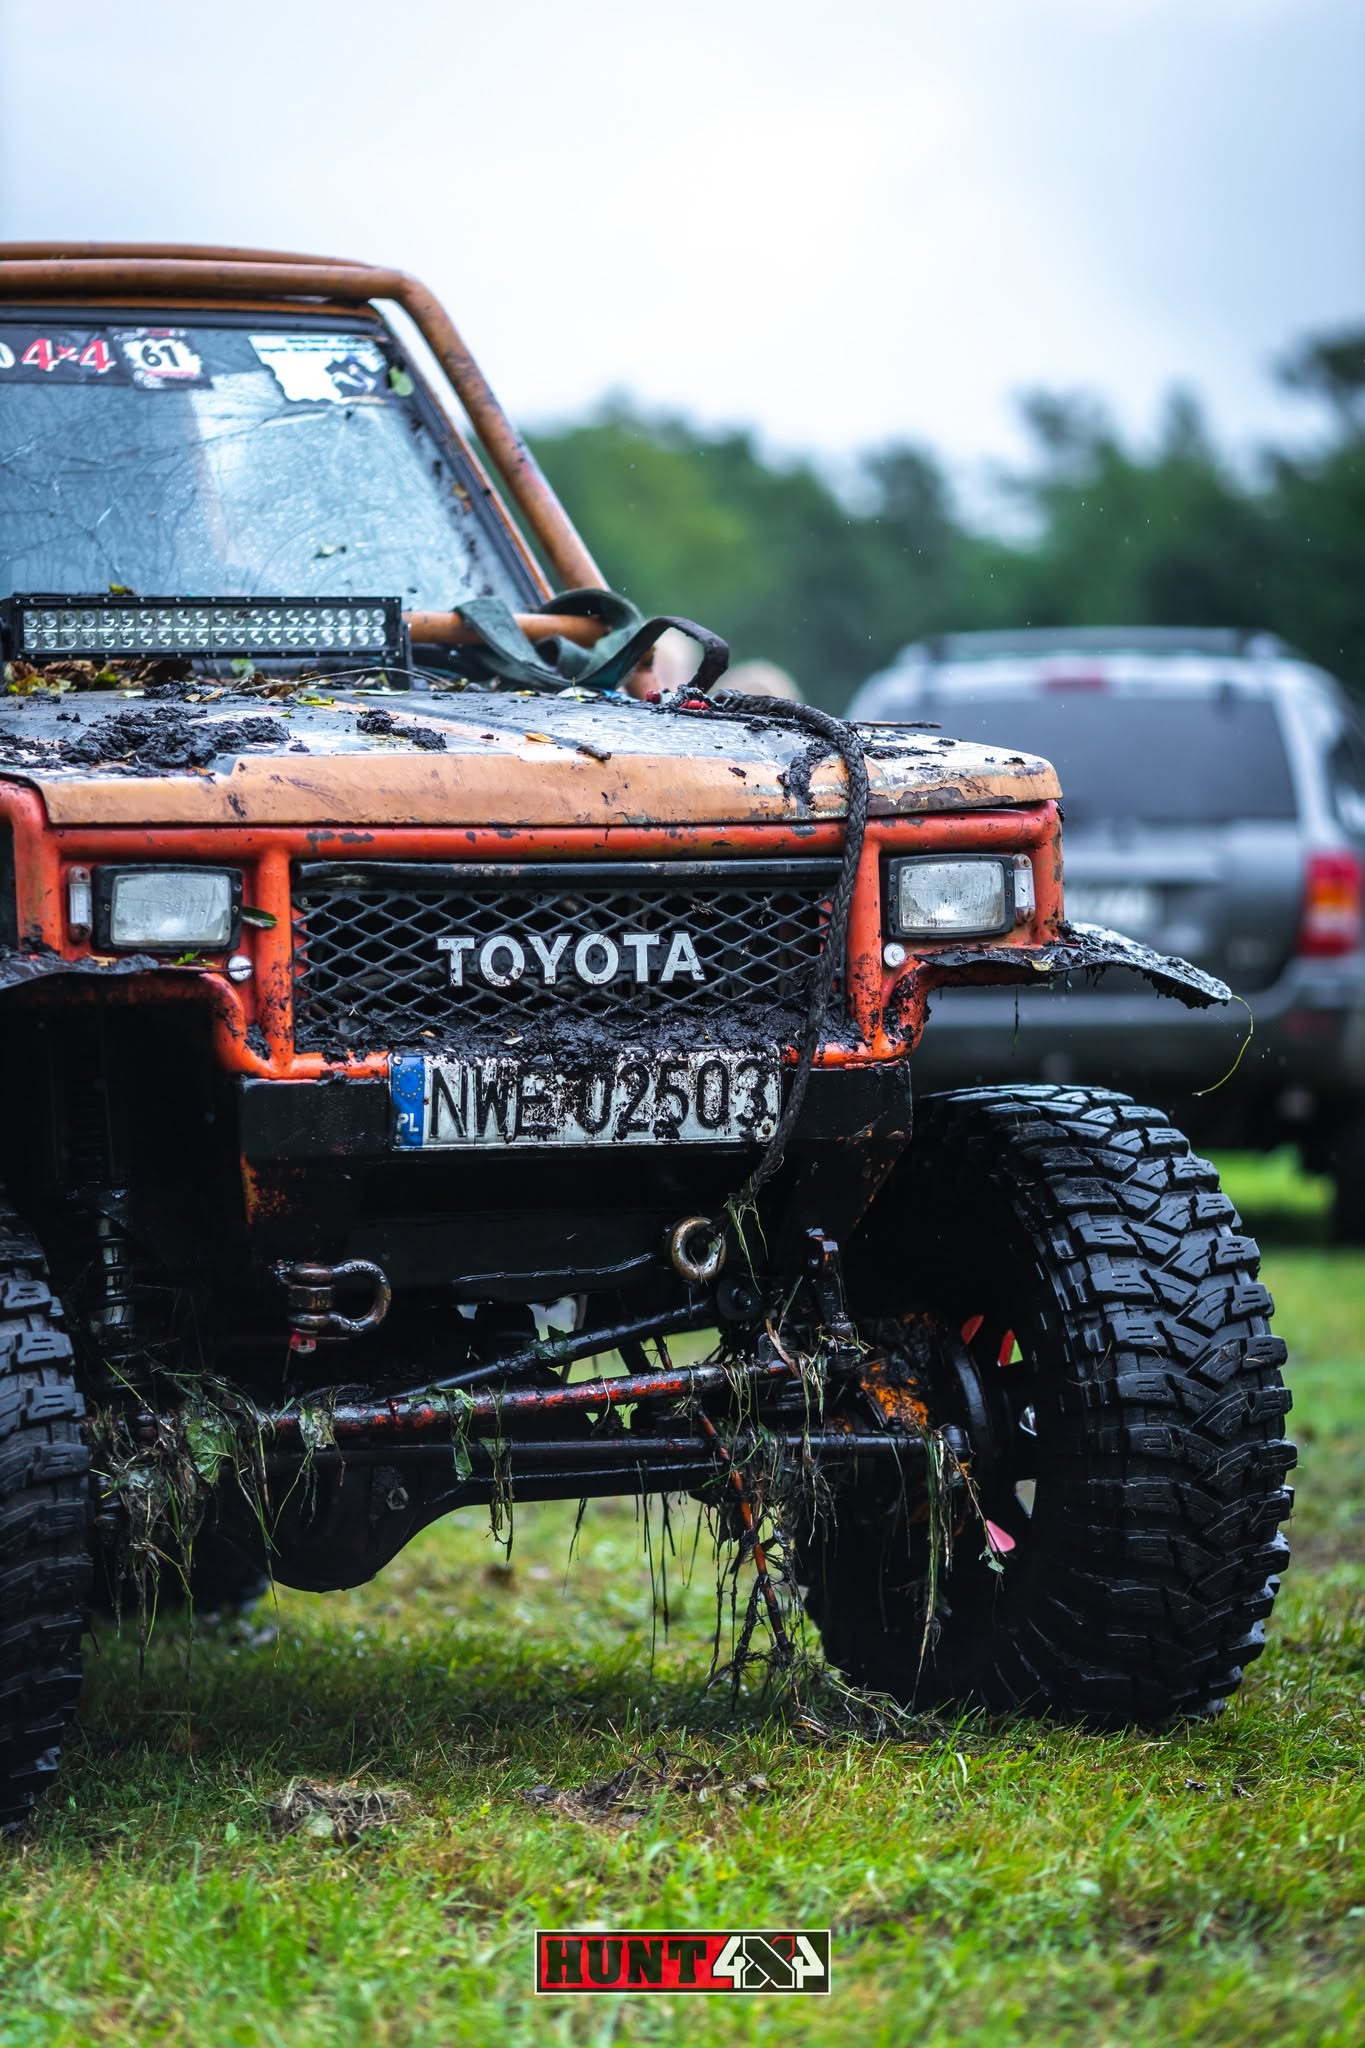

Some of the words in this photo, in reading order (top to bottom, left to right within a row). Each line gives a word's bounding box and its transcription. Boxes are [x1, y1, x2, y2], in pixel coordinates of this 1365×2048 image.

[141, 345, 180, 367] 61
[437, 932, 706, 987] TOYOTA
[429, 1064, 552, 1137] NWE
[397, 1113, 420, 1132] PL
